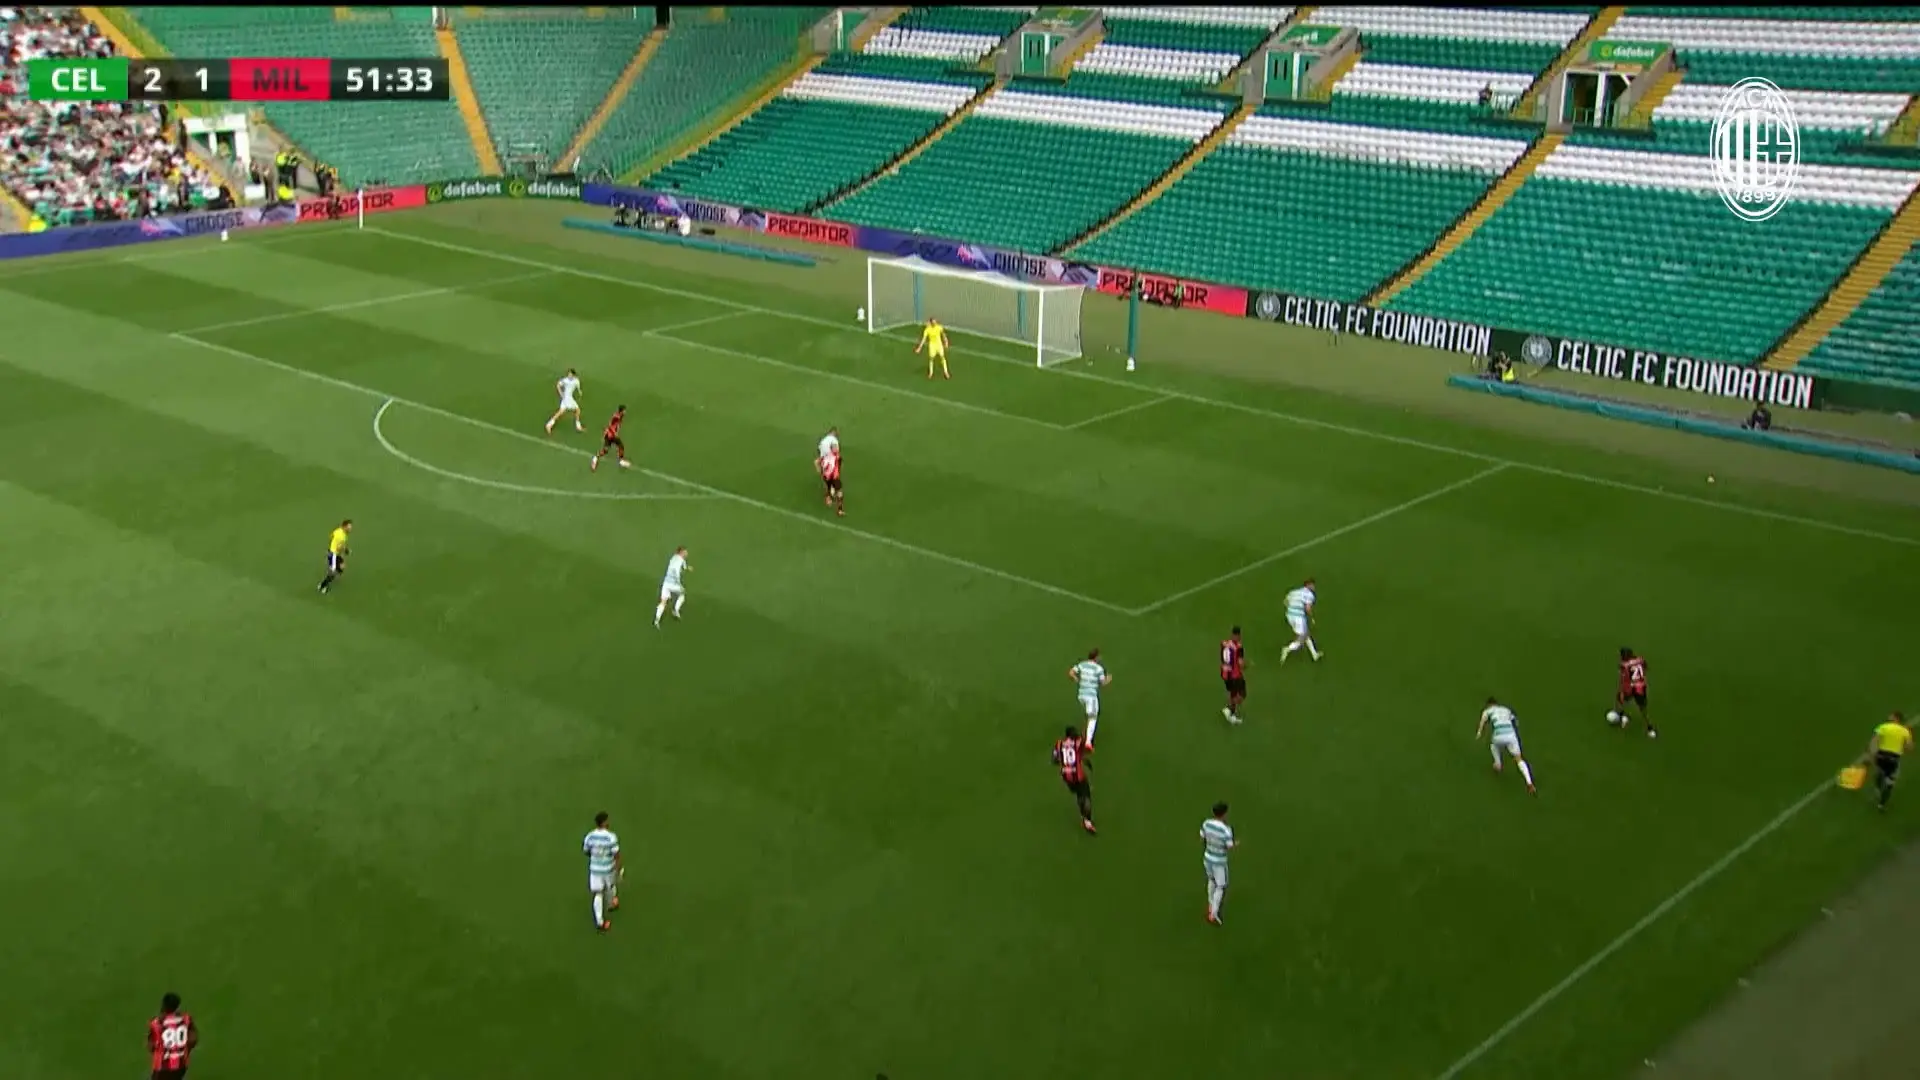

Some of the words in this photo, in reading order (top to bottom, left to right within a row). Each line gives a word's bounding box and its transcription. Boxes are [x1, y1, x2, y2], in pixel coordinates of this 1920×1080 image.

[443, 181, 501, 197] dafabet
[527, 181, 580, 198] dafabet
[768, 218, 849, 244] PREDATOR
[1284, 295, 1342, 331] CELTIC
[1346, 306, 1369, 336] FC
[1372, 310, 1492, 357] FOUNDATION
[1557, 339, 1627, 379] CELTIC
[1631, 351, 1659, 385] FC
[1663, 356, 1814, 409] FOUNDATION
[161, 1024, 188, 1049] 80
